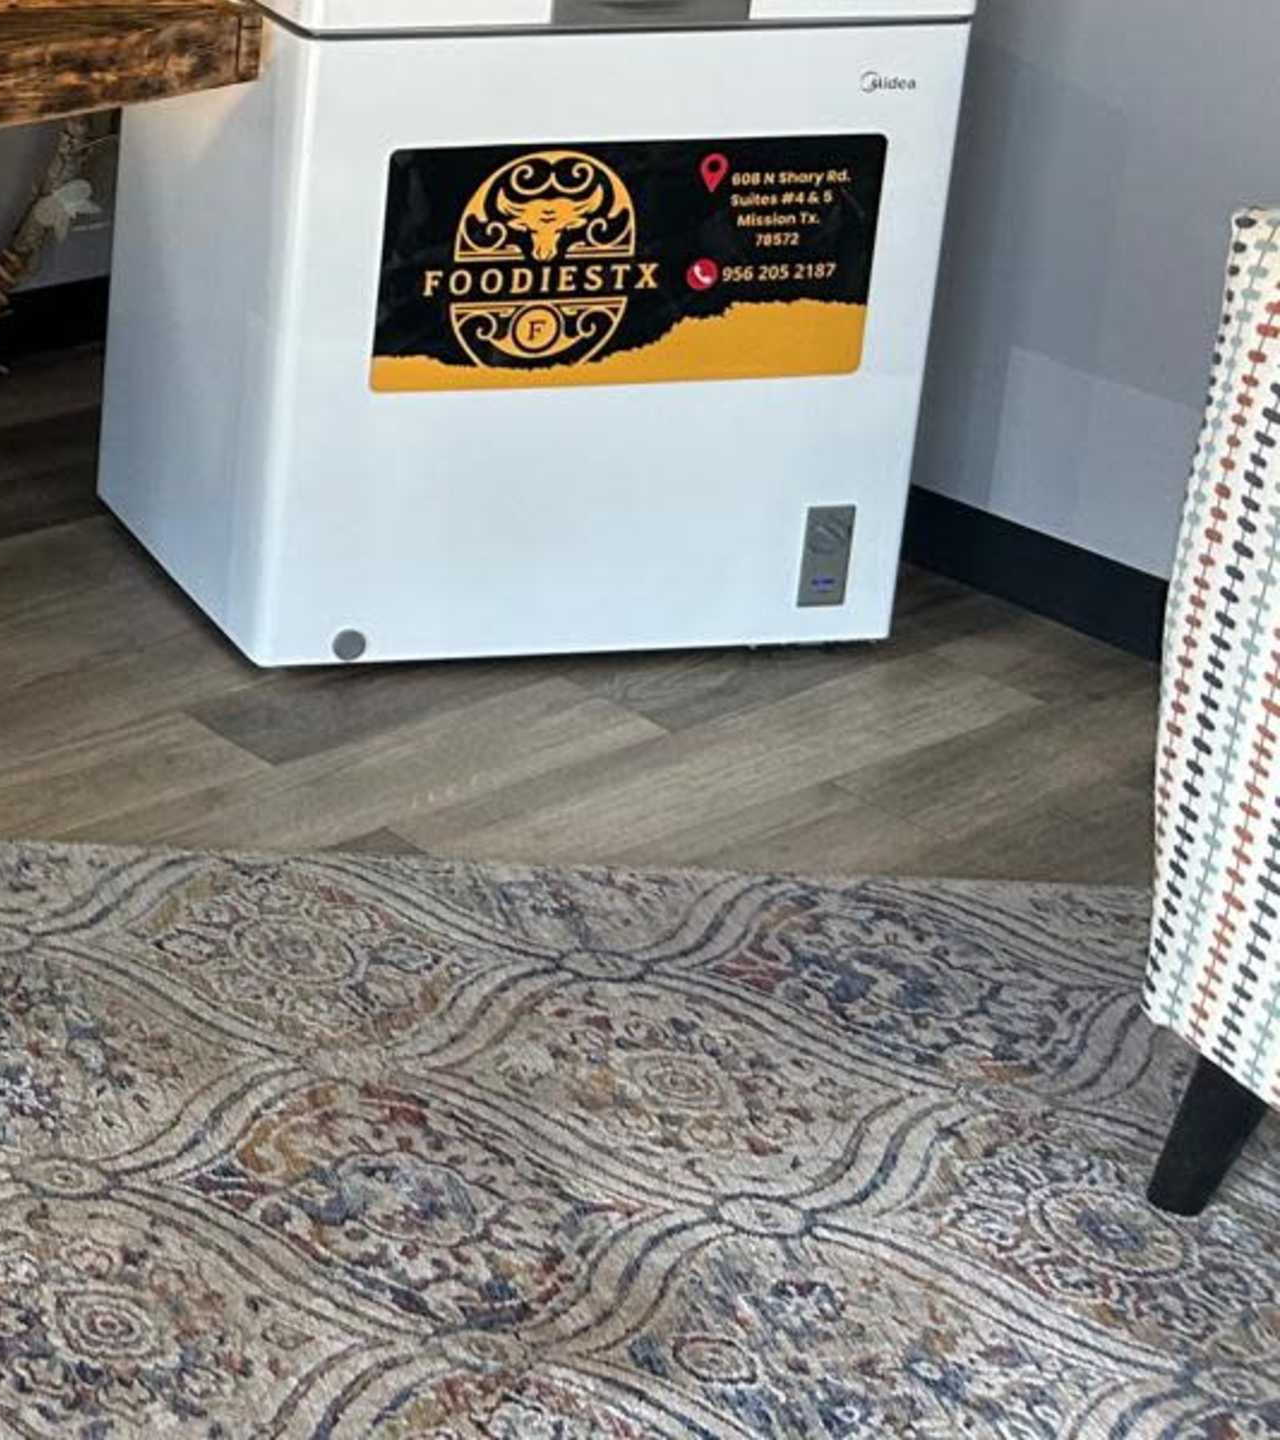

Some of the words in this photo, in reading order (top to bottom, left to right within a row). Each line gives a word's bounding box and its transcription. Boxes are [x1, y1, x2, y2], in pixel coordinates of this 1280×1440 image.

[859, 69, 916, 93] Midea
[731, 171, 761, 186] 608
[763, 172, 775, 185] N
[778, 170, 825, 187] Shary
[826, 168, 851, 183] Rd.
[730, 193, 777, 207] Suites
[780, 191, 804, 205] #4
[807, 191, 820, 204] &
[823, 190, 833, 203] 5
[737, 212, 796, 227] Mission
[800, 212, 820, 225] Tx.
[755, 232, 801, 247] 78572
[423, 263, 660, 297] FOODIESTX
[722, 266, 753, 282] 956
[758, 264, 789, 280] 205
[794, 262, 837, 279] 2187
[527, 320, 546, 341] F
